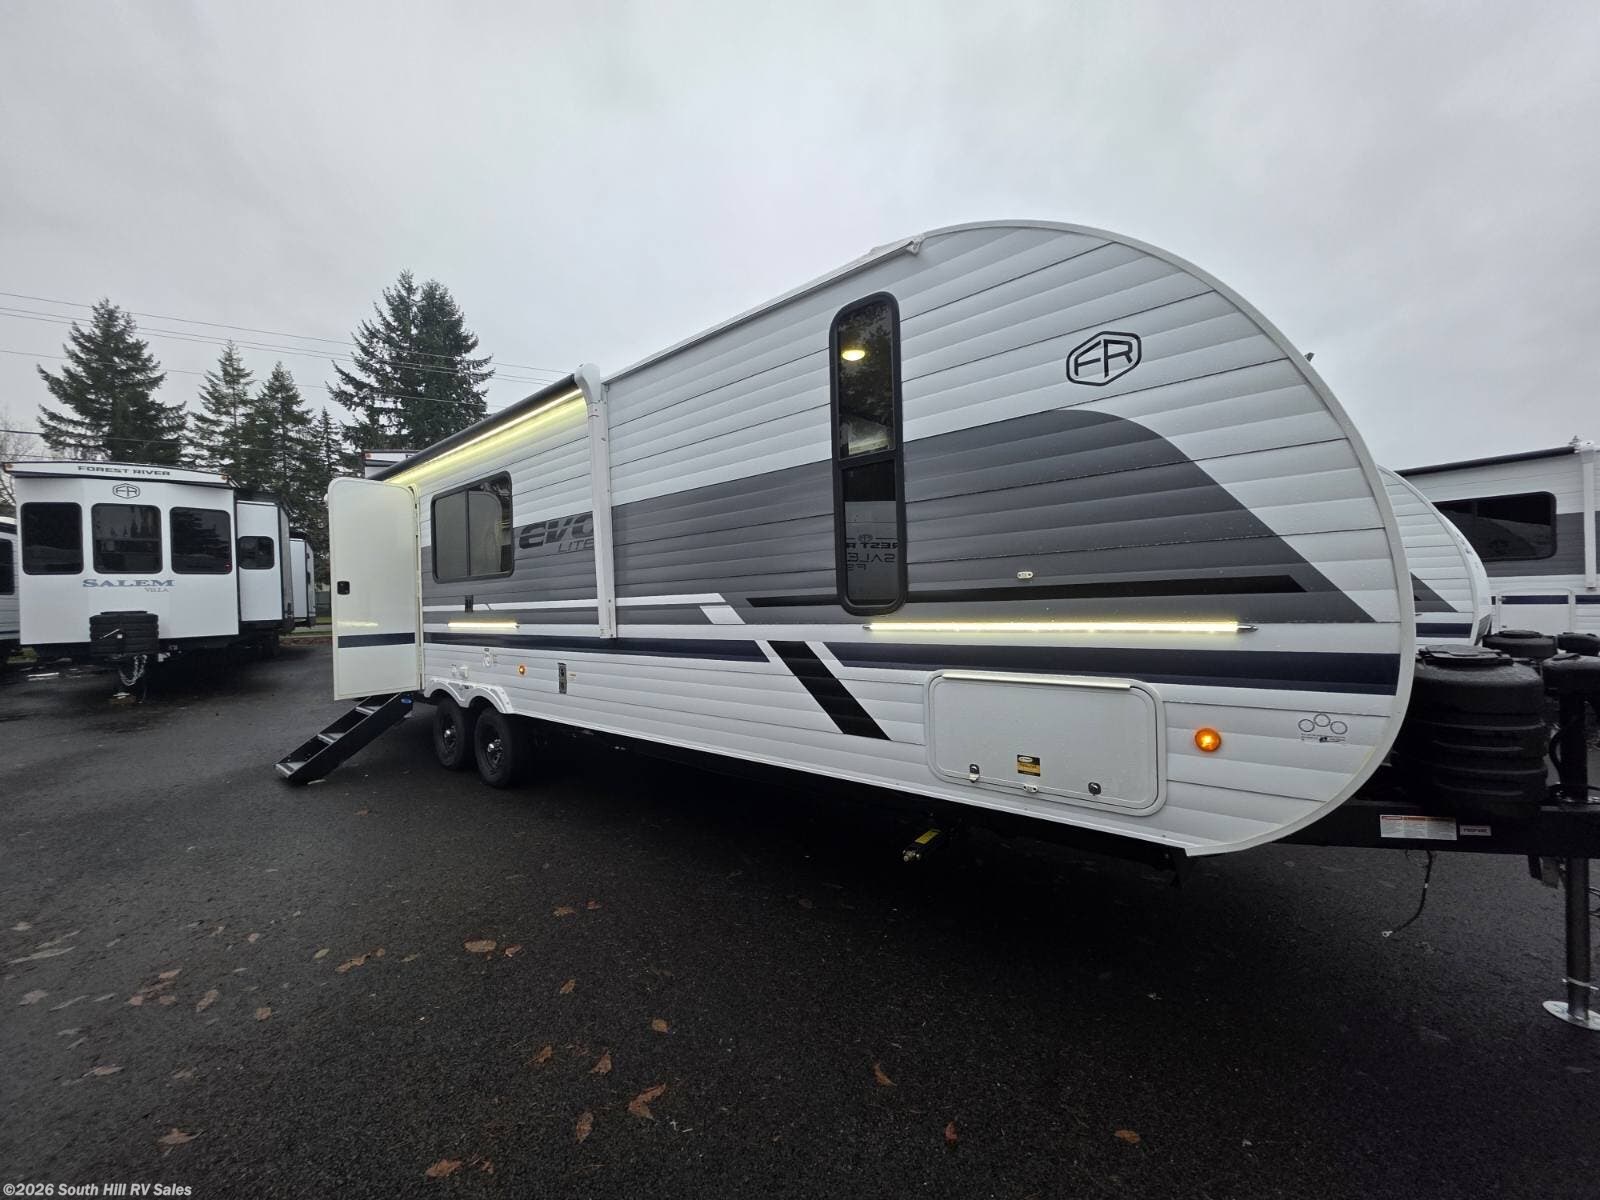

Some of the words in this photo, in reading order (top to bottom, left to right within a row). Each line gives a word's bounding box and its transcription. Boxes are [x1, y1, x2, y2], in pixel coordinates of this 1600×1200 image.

[1073, 338, 1133, 379] FR
[77, 465, 129, 474] FOREST
[82, 578, 176, 588] SALEM
